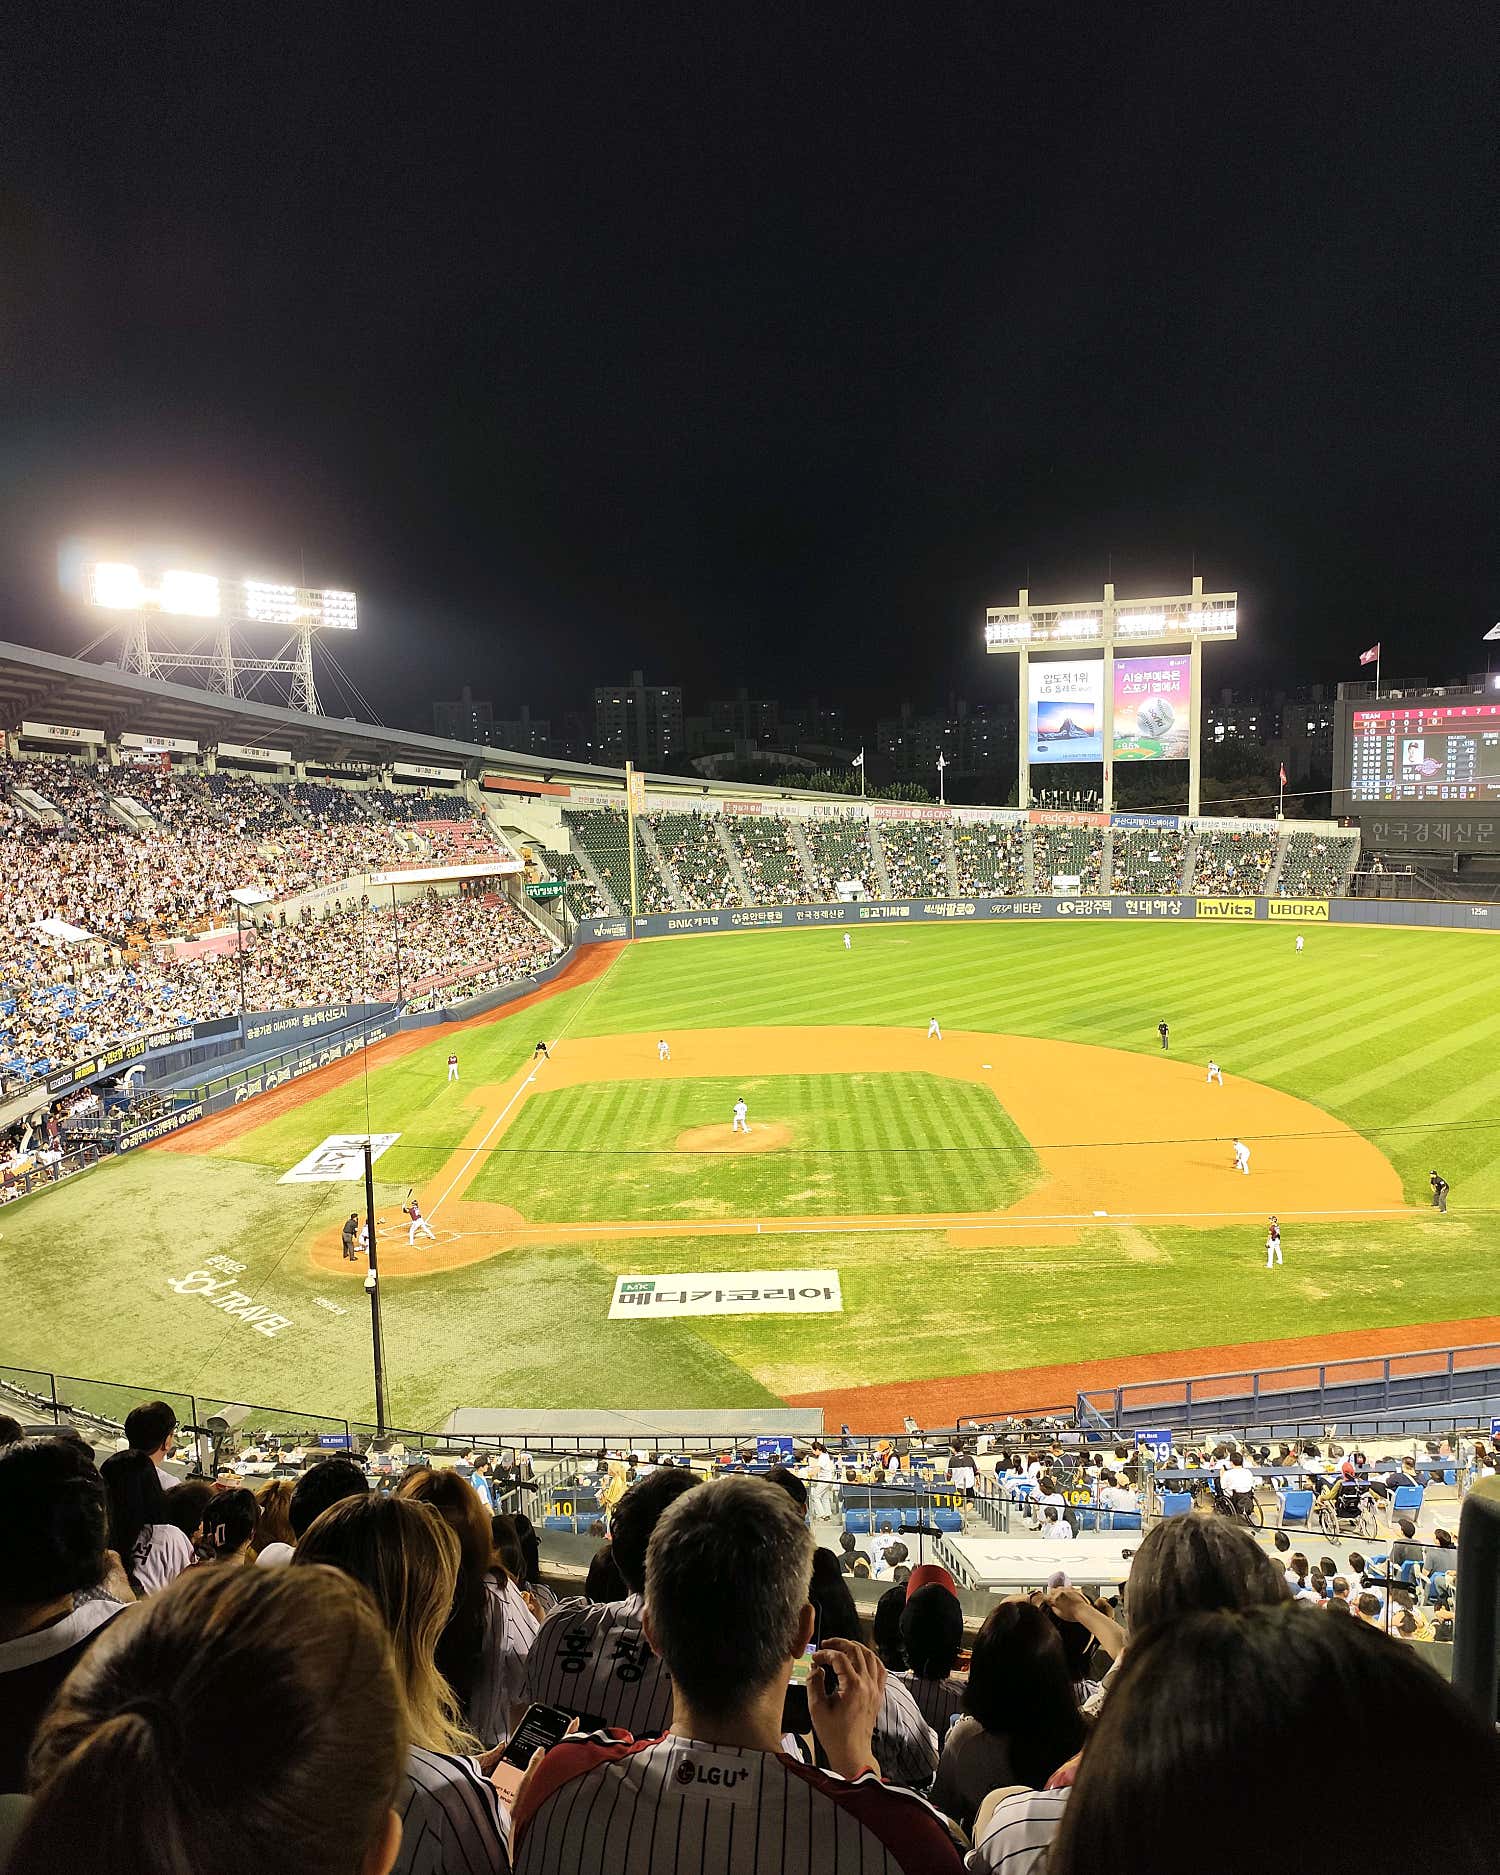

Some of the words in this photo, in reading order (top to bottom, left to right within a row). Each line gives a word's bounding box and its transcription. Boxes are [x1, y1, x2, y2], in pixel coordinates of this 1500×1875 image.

[1043, 672, 1071, 685] 압도적
[1075, 672, 1088, 683] 1위
[1040, 813, 1076, 824] redcap
[1372, 822, 1496, 843] 한국경제신문
[1013, 902, 1042, 914] 비타란
[1075, 900, 1112, 914] 금강주택
[1125, 900, 1182, 915] 현대해상
[1270, 904, 1327, 916] UBORA
[1471, 907, 1488, 916] 125m
[741, 911, 783, 921] 유안타증권
[796, 909, 846, 921] 한국경제신문
[247, 1023, 272, 1040] 공공기관
[302, 1006, 348, 1028] 충남혁신도시
[626, 1283, 650, 1292] MK
[618, 1287, 836, 1305] 메디카코리아
[211, 1290, 294, 1338] TRAVEL
[934, 1491, 963, 1507] 110
[544, 1501, 573, 1517] 110
[697, 1765, 749, 1788] LGU+
